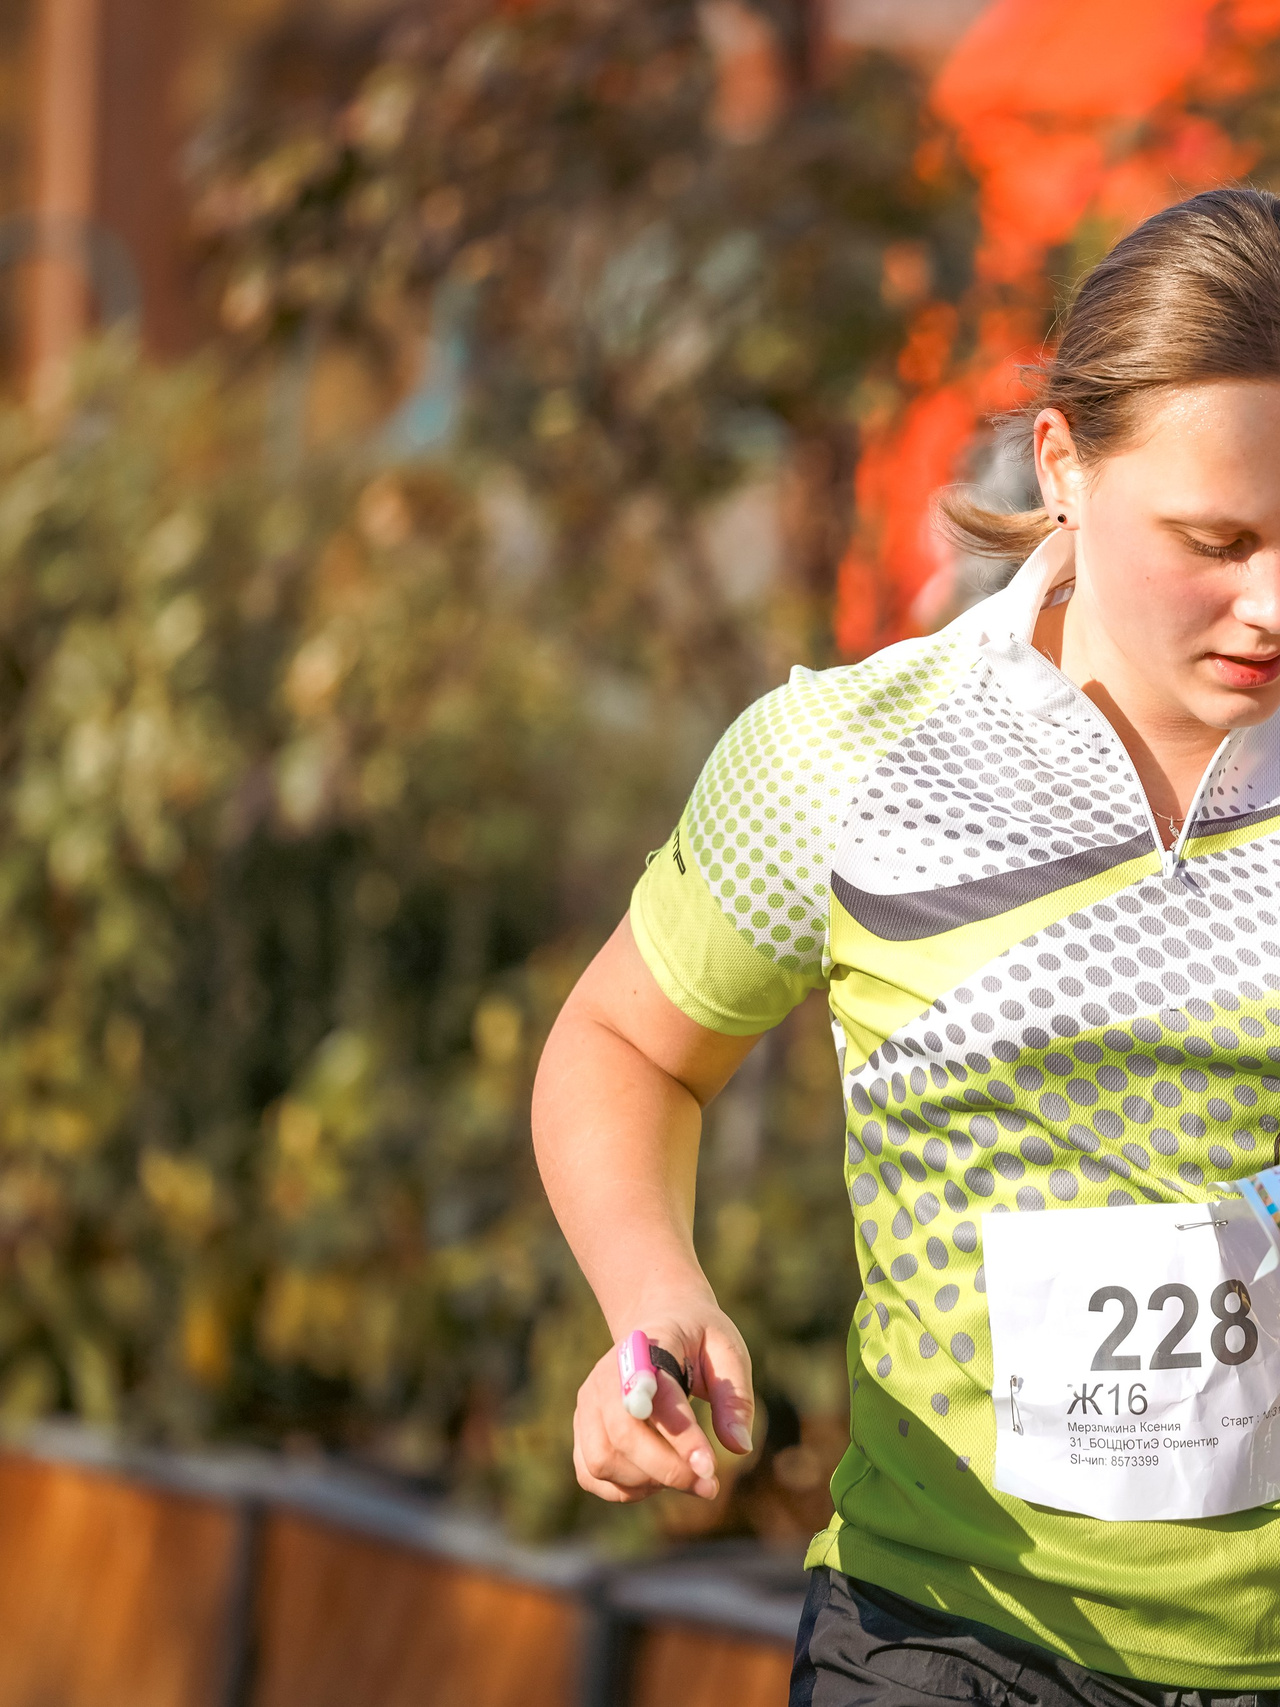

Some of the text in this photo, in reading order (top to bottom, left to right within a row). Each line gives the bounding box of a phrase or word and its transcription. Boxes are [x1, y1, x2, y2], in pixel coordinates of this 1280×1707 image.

[1088, 1279, 1258, 1371] 228
[1066, 1383, 1148, 1416] Ж16
[1067, 1421, 1181, 1434] Мерзликина Ксения
[1069, 1437, 1219, 1451] 31_БОЦДЮТиЭ Ориентир
[1070, 1453, 1159, 1467] SI-чип: 8573399
